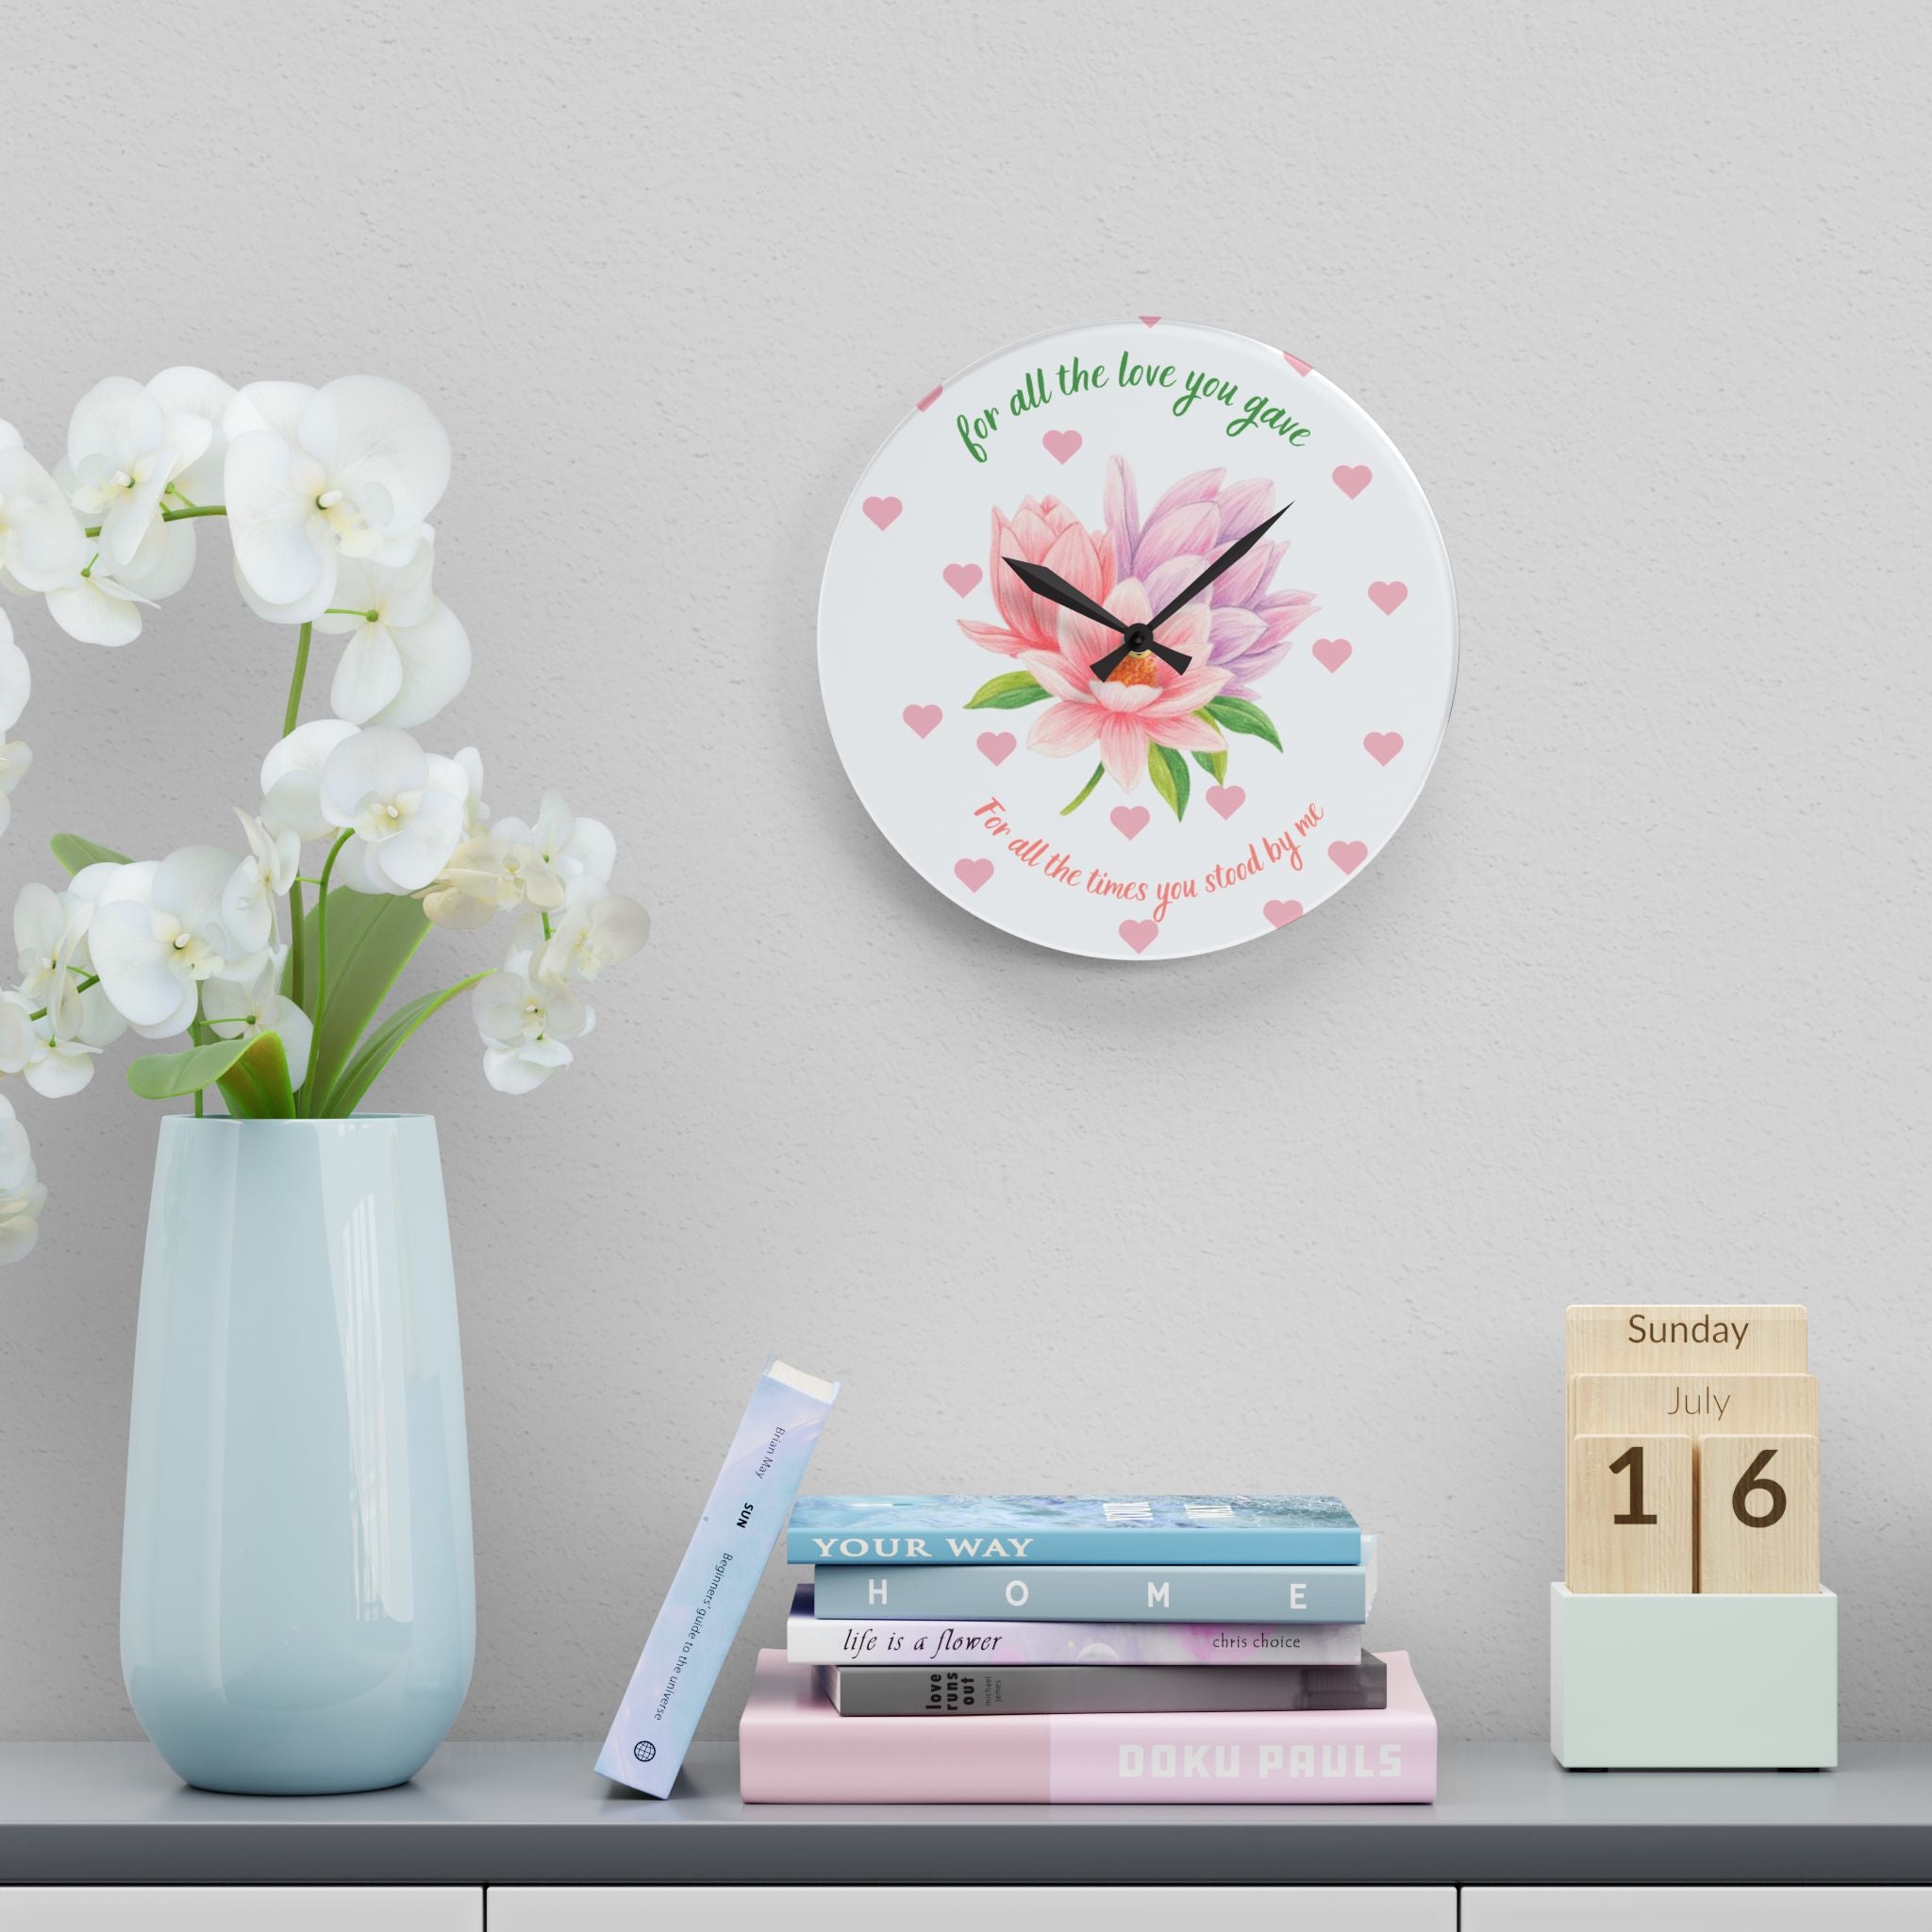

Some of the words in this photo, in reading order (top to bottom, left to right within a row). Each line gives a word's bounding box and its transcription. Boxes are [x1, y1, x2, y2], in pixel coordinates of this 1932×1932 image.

[957, 407, 1000, 463] for
[1009, 368, 1053, 416] all
[1056, 356, 1109, 396] the
[1118, 350, 1177, 389] love
[1172, 370, 1239, 417] you
[1225, 395, 1311, 447] gave
[974, 796, 1011, 836] For
[1008, 839, 1050, 867] all
[1043, 853, 1082, 887] the
[1086, 868, 1148, 901] times
[1153, 878, 1198, 923] you
[1205, 843, 1265, 892] stood
[1261, 831, 1302, 872] by
[1294, 803, 1324, 837] me
[1627, 1313, 1750, 1350] Sunday
[1667, 1386, 1731, 1421] July
[767, 1426, 786, 1455] Brian
[755, 1456, 774, 1480] May
[736, 1502, 755, 1529] SUN
[811, 1538, 933, 1557] YOUR
[945, 1538, 1035, 1557] WAY
[689, 1607, 708, 1640] guide
[682, 1641, 693, 1653] to
[843, 1628, 877, 1659] life
[888, 1632, 905, 1651] is
[913, 1636, 928, 1651] a
[929, 1628, 1003, 1659] flower
[1212, 1633, 1248, 1649] chris
[1253, 1633, 1301, 1649] choice
[674, 1656, 688, 1674] the
[655, 1675, 678, 1722] universe
[925, 1674, 942, 1709] love
[946, 1673, 958, 1711] runs
[960, 1676, 974, 1706] out
[984, 1675, 992, 1707] michael
[1118, 1745, 1241, 1778] DOKU
[1258, 1745, 1402, 1778] PAULS
